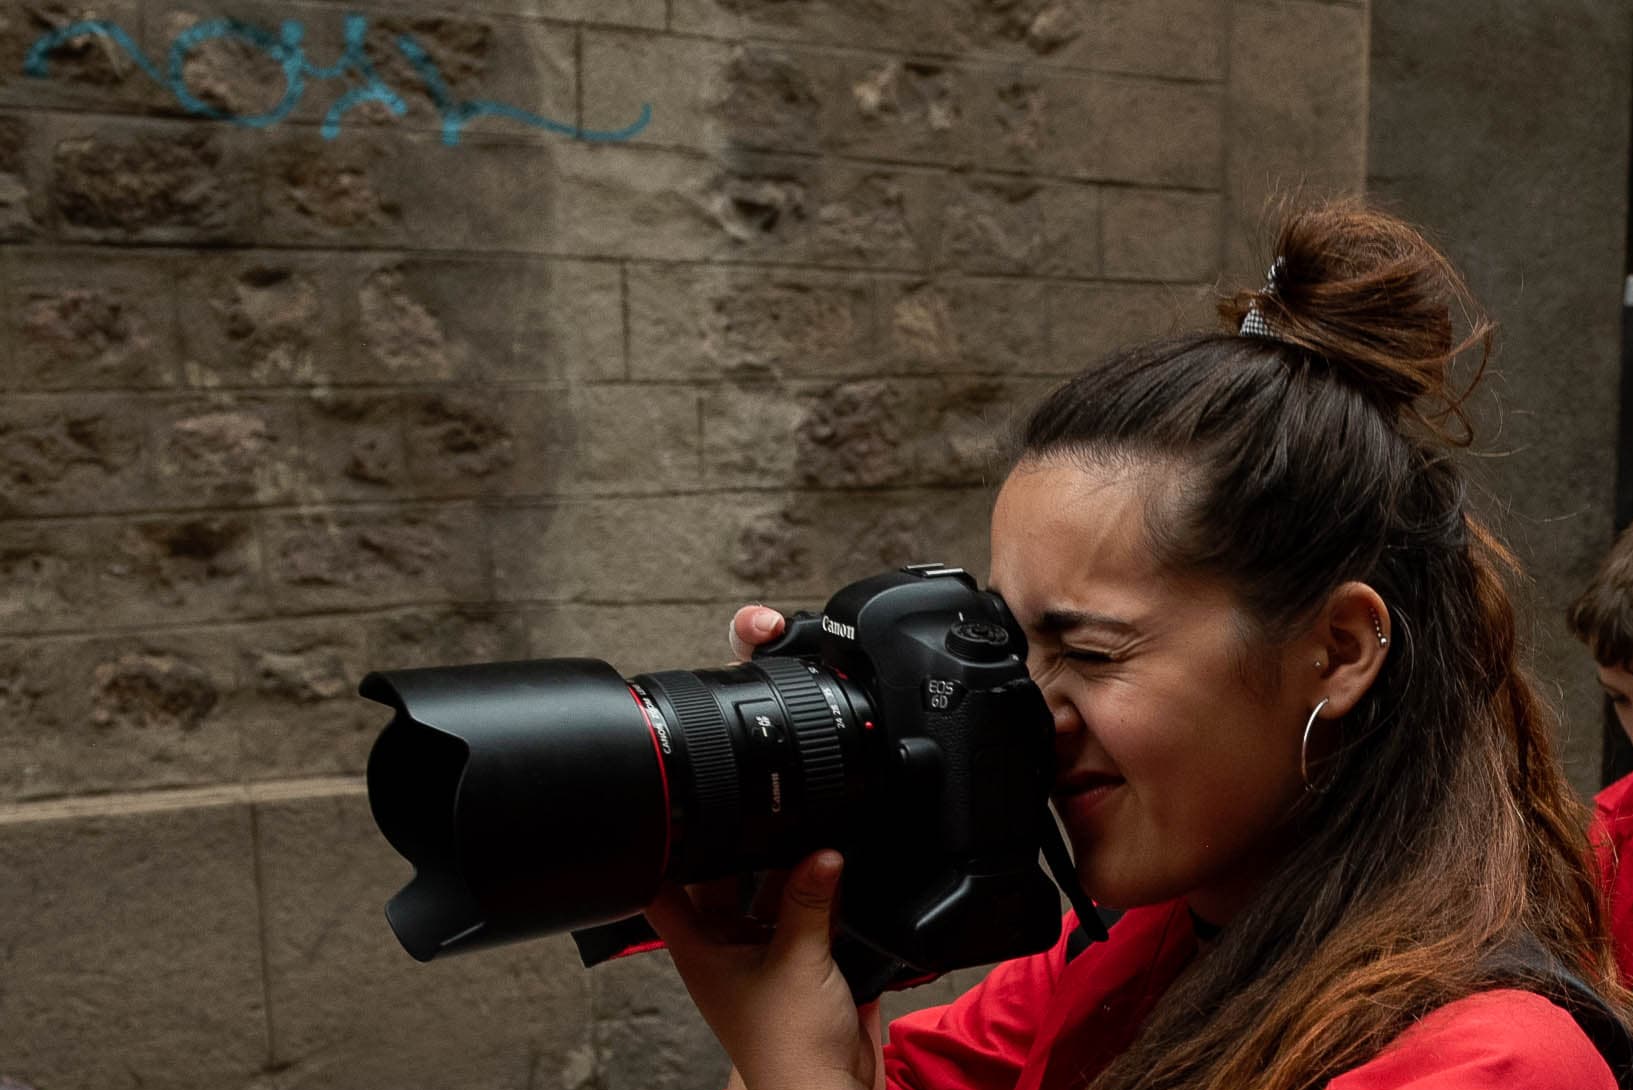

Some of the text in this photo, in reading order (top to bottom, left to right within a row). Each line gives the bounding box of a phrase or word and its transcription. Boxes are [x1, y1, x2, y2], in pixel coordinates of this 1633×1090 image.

[822, 616, 855, 641] Canon
[928, 680, 954, 695] EOS
[931, 696, 948, 709] 6D
